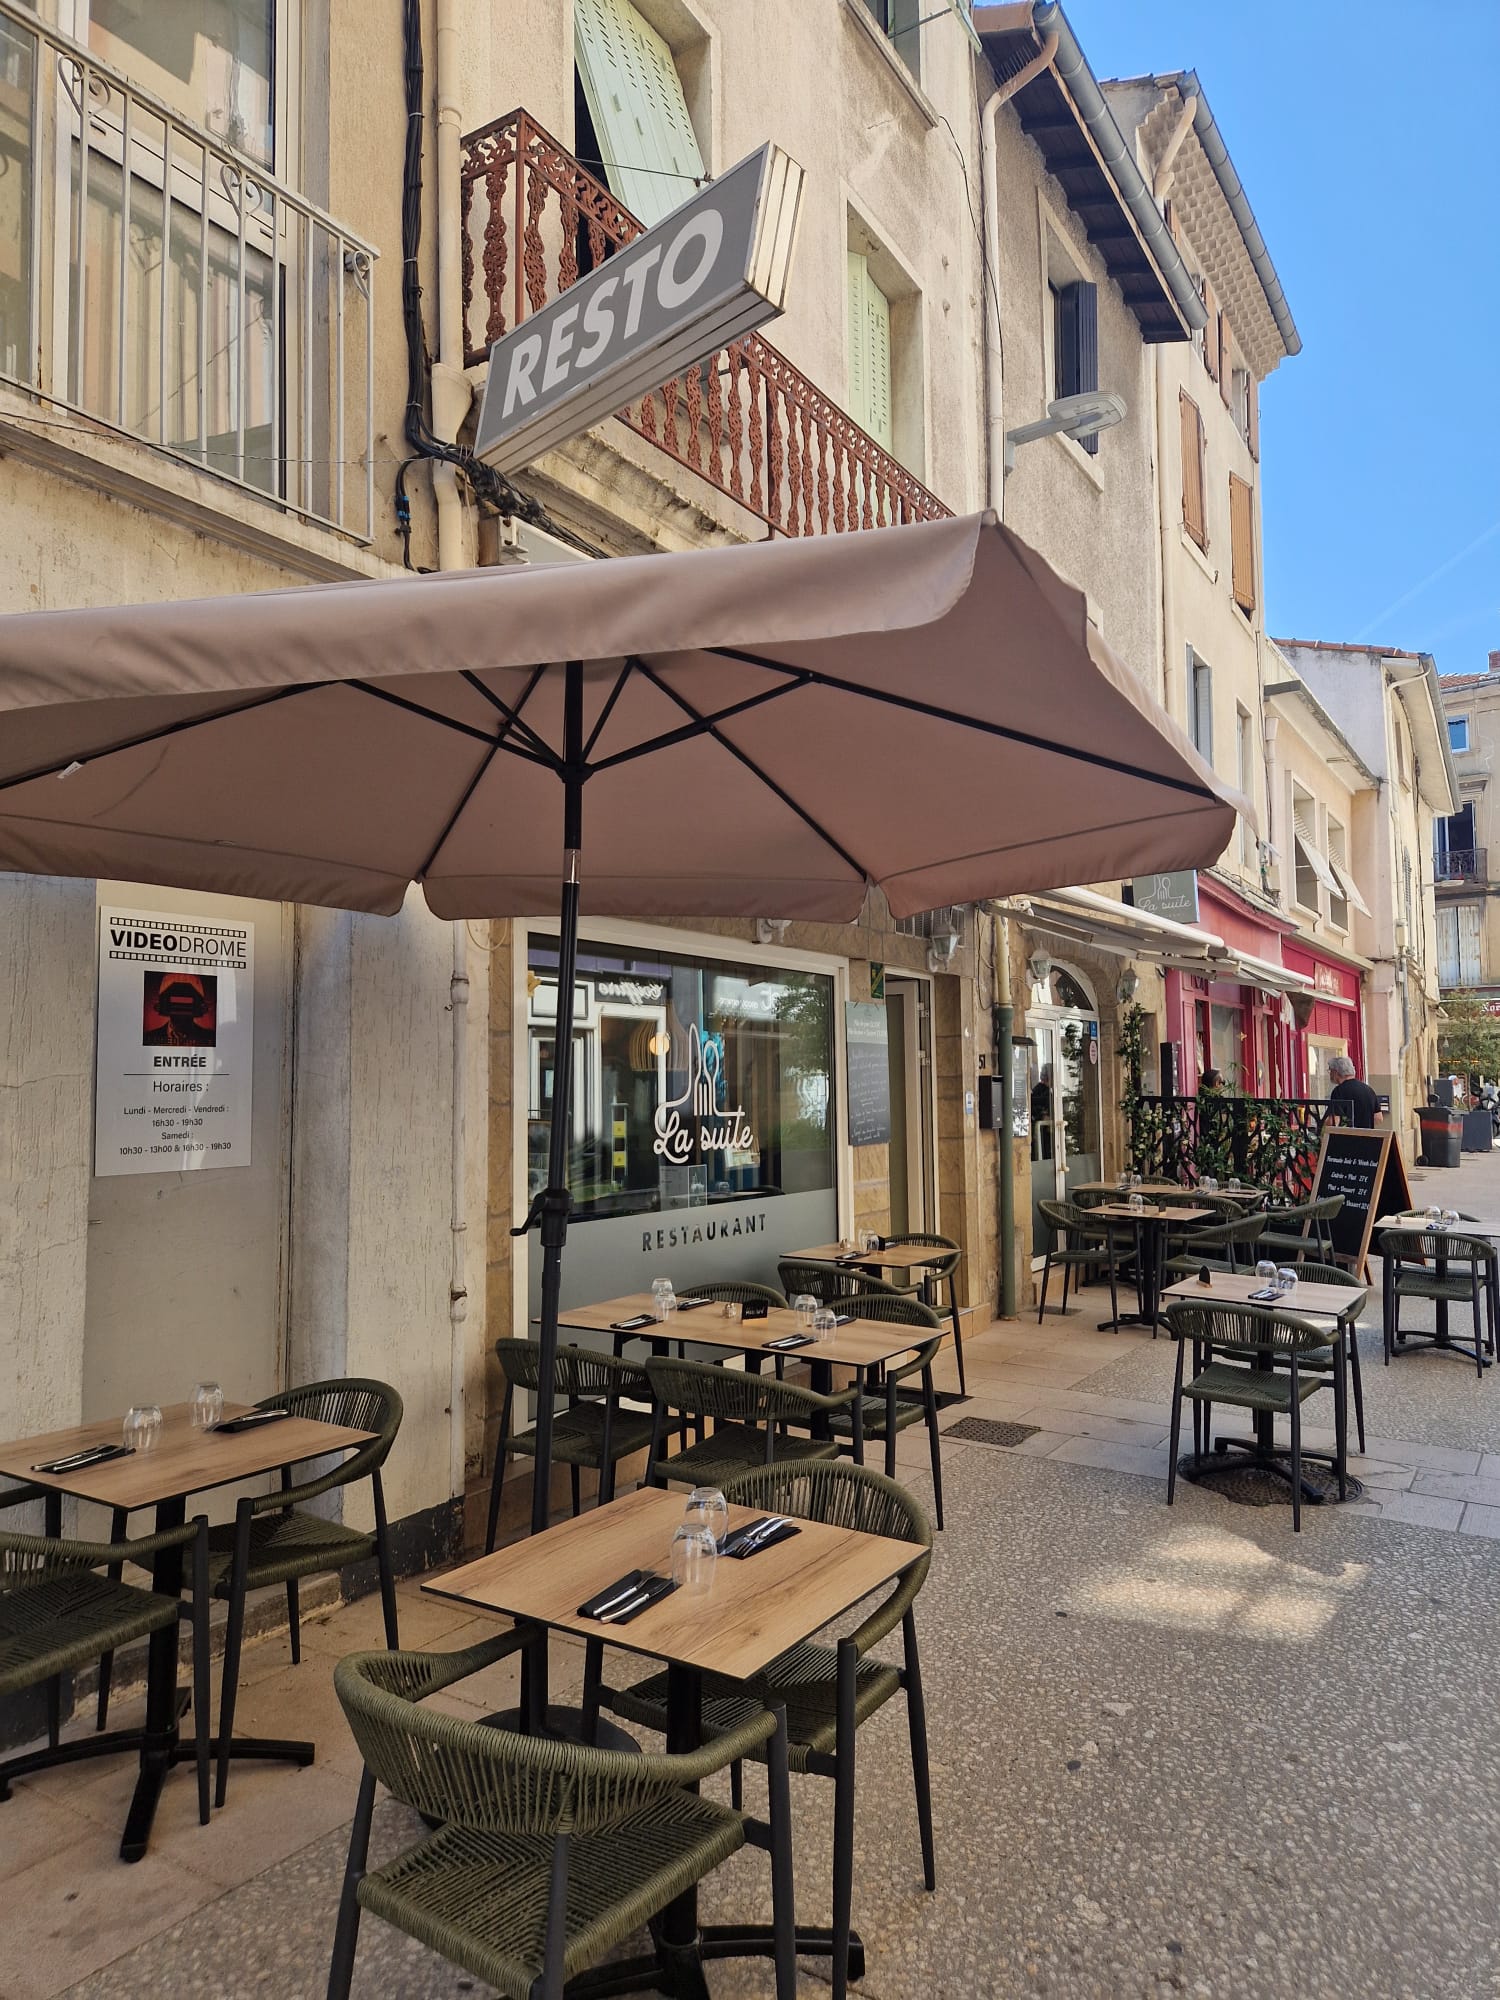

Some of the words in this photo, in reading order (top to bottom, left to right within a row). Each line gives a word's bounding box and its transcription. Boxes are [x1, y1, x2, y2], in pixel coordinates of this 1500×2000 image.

[501, 208, 724, 420] RESTO
[1161, 894, 1192, 910] suite
[110, 929, 247, 958] VIDEODROME
[153, 1053, 207, 1068] ENTRÉE
[153, 1080, 203, 1093] Horaires
[123, 1105, 146, 1115] Lundi
[153, 1105, 187, 1114] Mercredi
[193, 1104, 225, 1113] Vendredi
[152, 1119, 175, 1128] 16h30
[182, 1118, 203, 1127] 19h30
[161, 1130, 190, 1140] Samedi
[653, 1103, 694, 1164] La
[700, 1105, 754, 1151] suite
[120, 1146, 143, 1155] 10h30
[150, 1145, 173, 1153] 13h00
[174, 1144, 181, 1152] &
[182, 1143, 204, 1152] 16h30
[210, 1142, 232, 1151] 19h30
[642, 1213, 766, 1252] RESTAURANT
